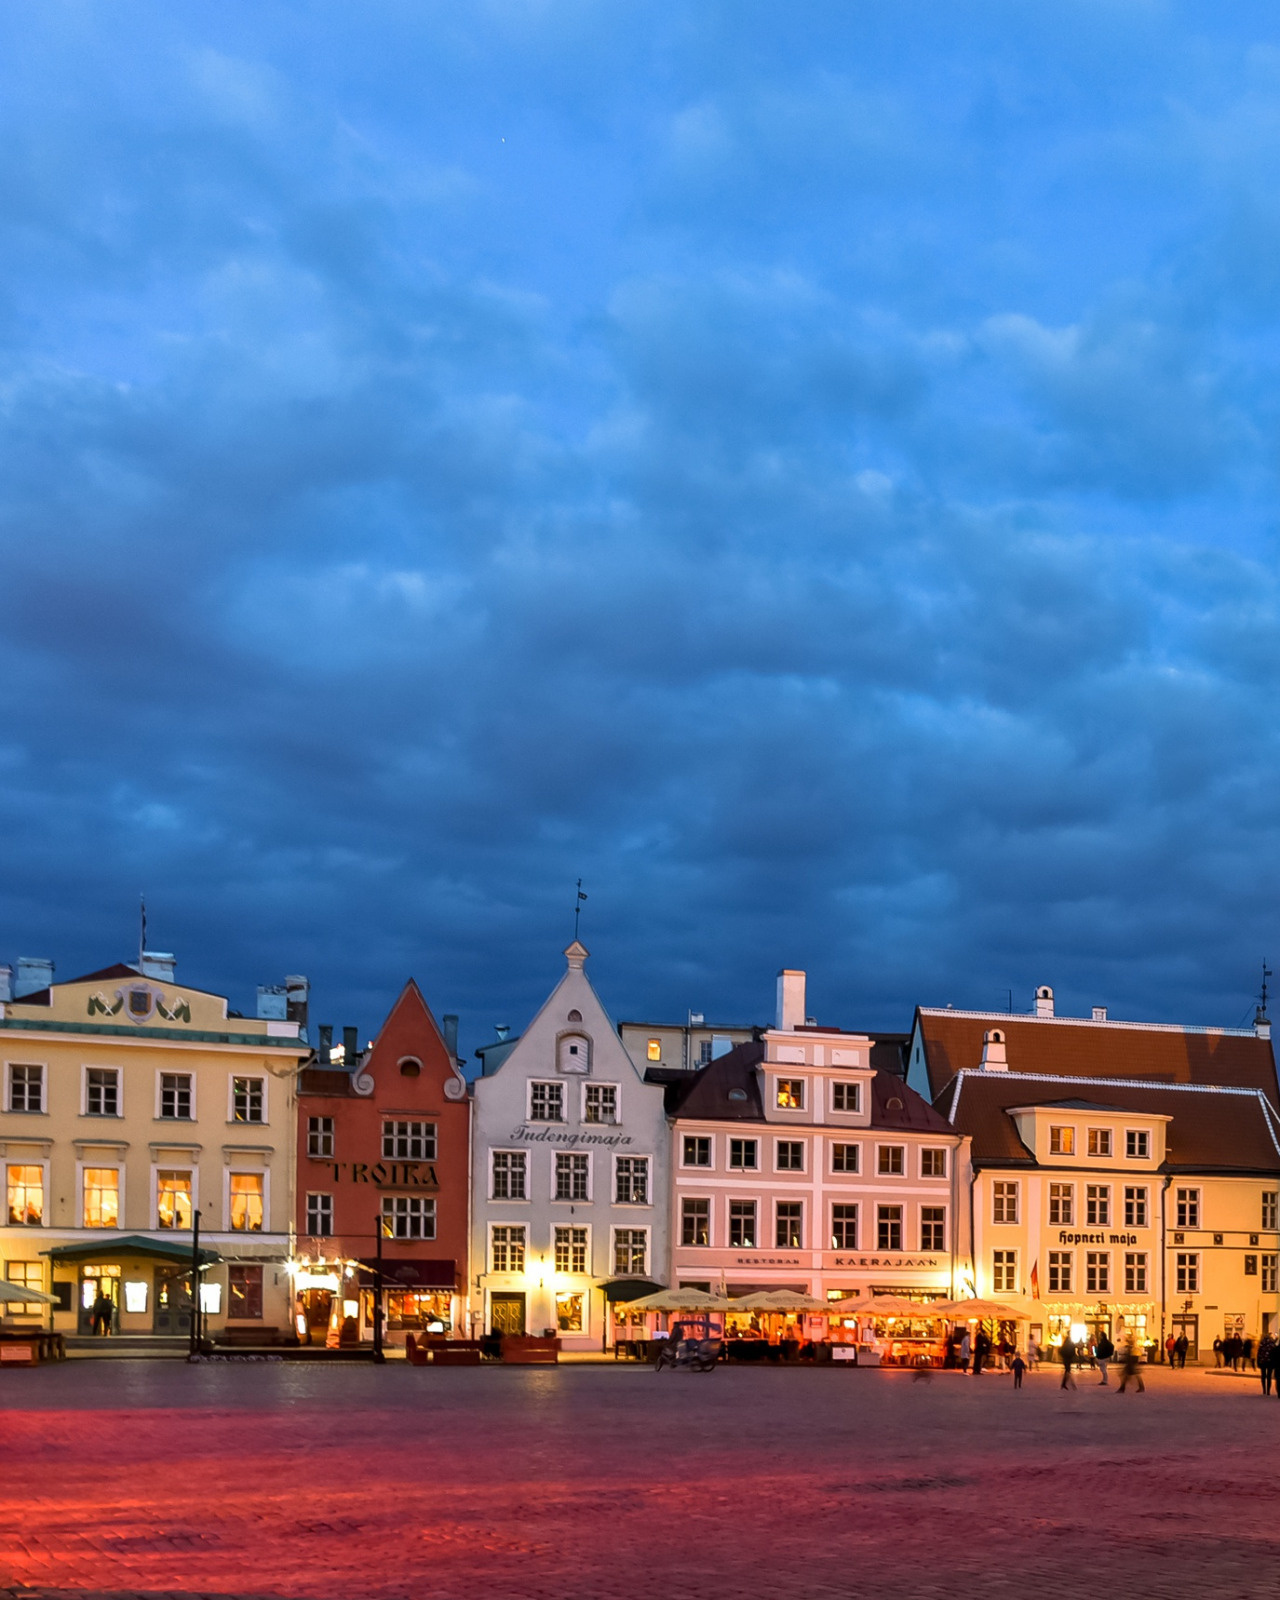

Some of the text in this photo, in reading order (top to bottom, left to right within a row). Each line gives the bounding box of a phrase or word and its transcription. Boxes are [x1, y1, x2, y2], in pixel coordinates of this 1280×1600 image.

[510, 1124, 634, 1151] Tudengimaja
[326, 1162, 439, 1186] TROIKA
[1109, 1232, 1137, 1247] maja
[737, 1257, 800, 1265] RESTORAN
[835, 1257, 938, 1267] KAERAJAAN
